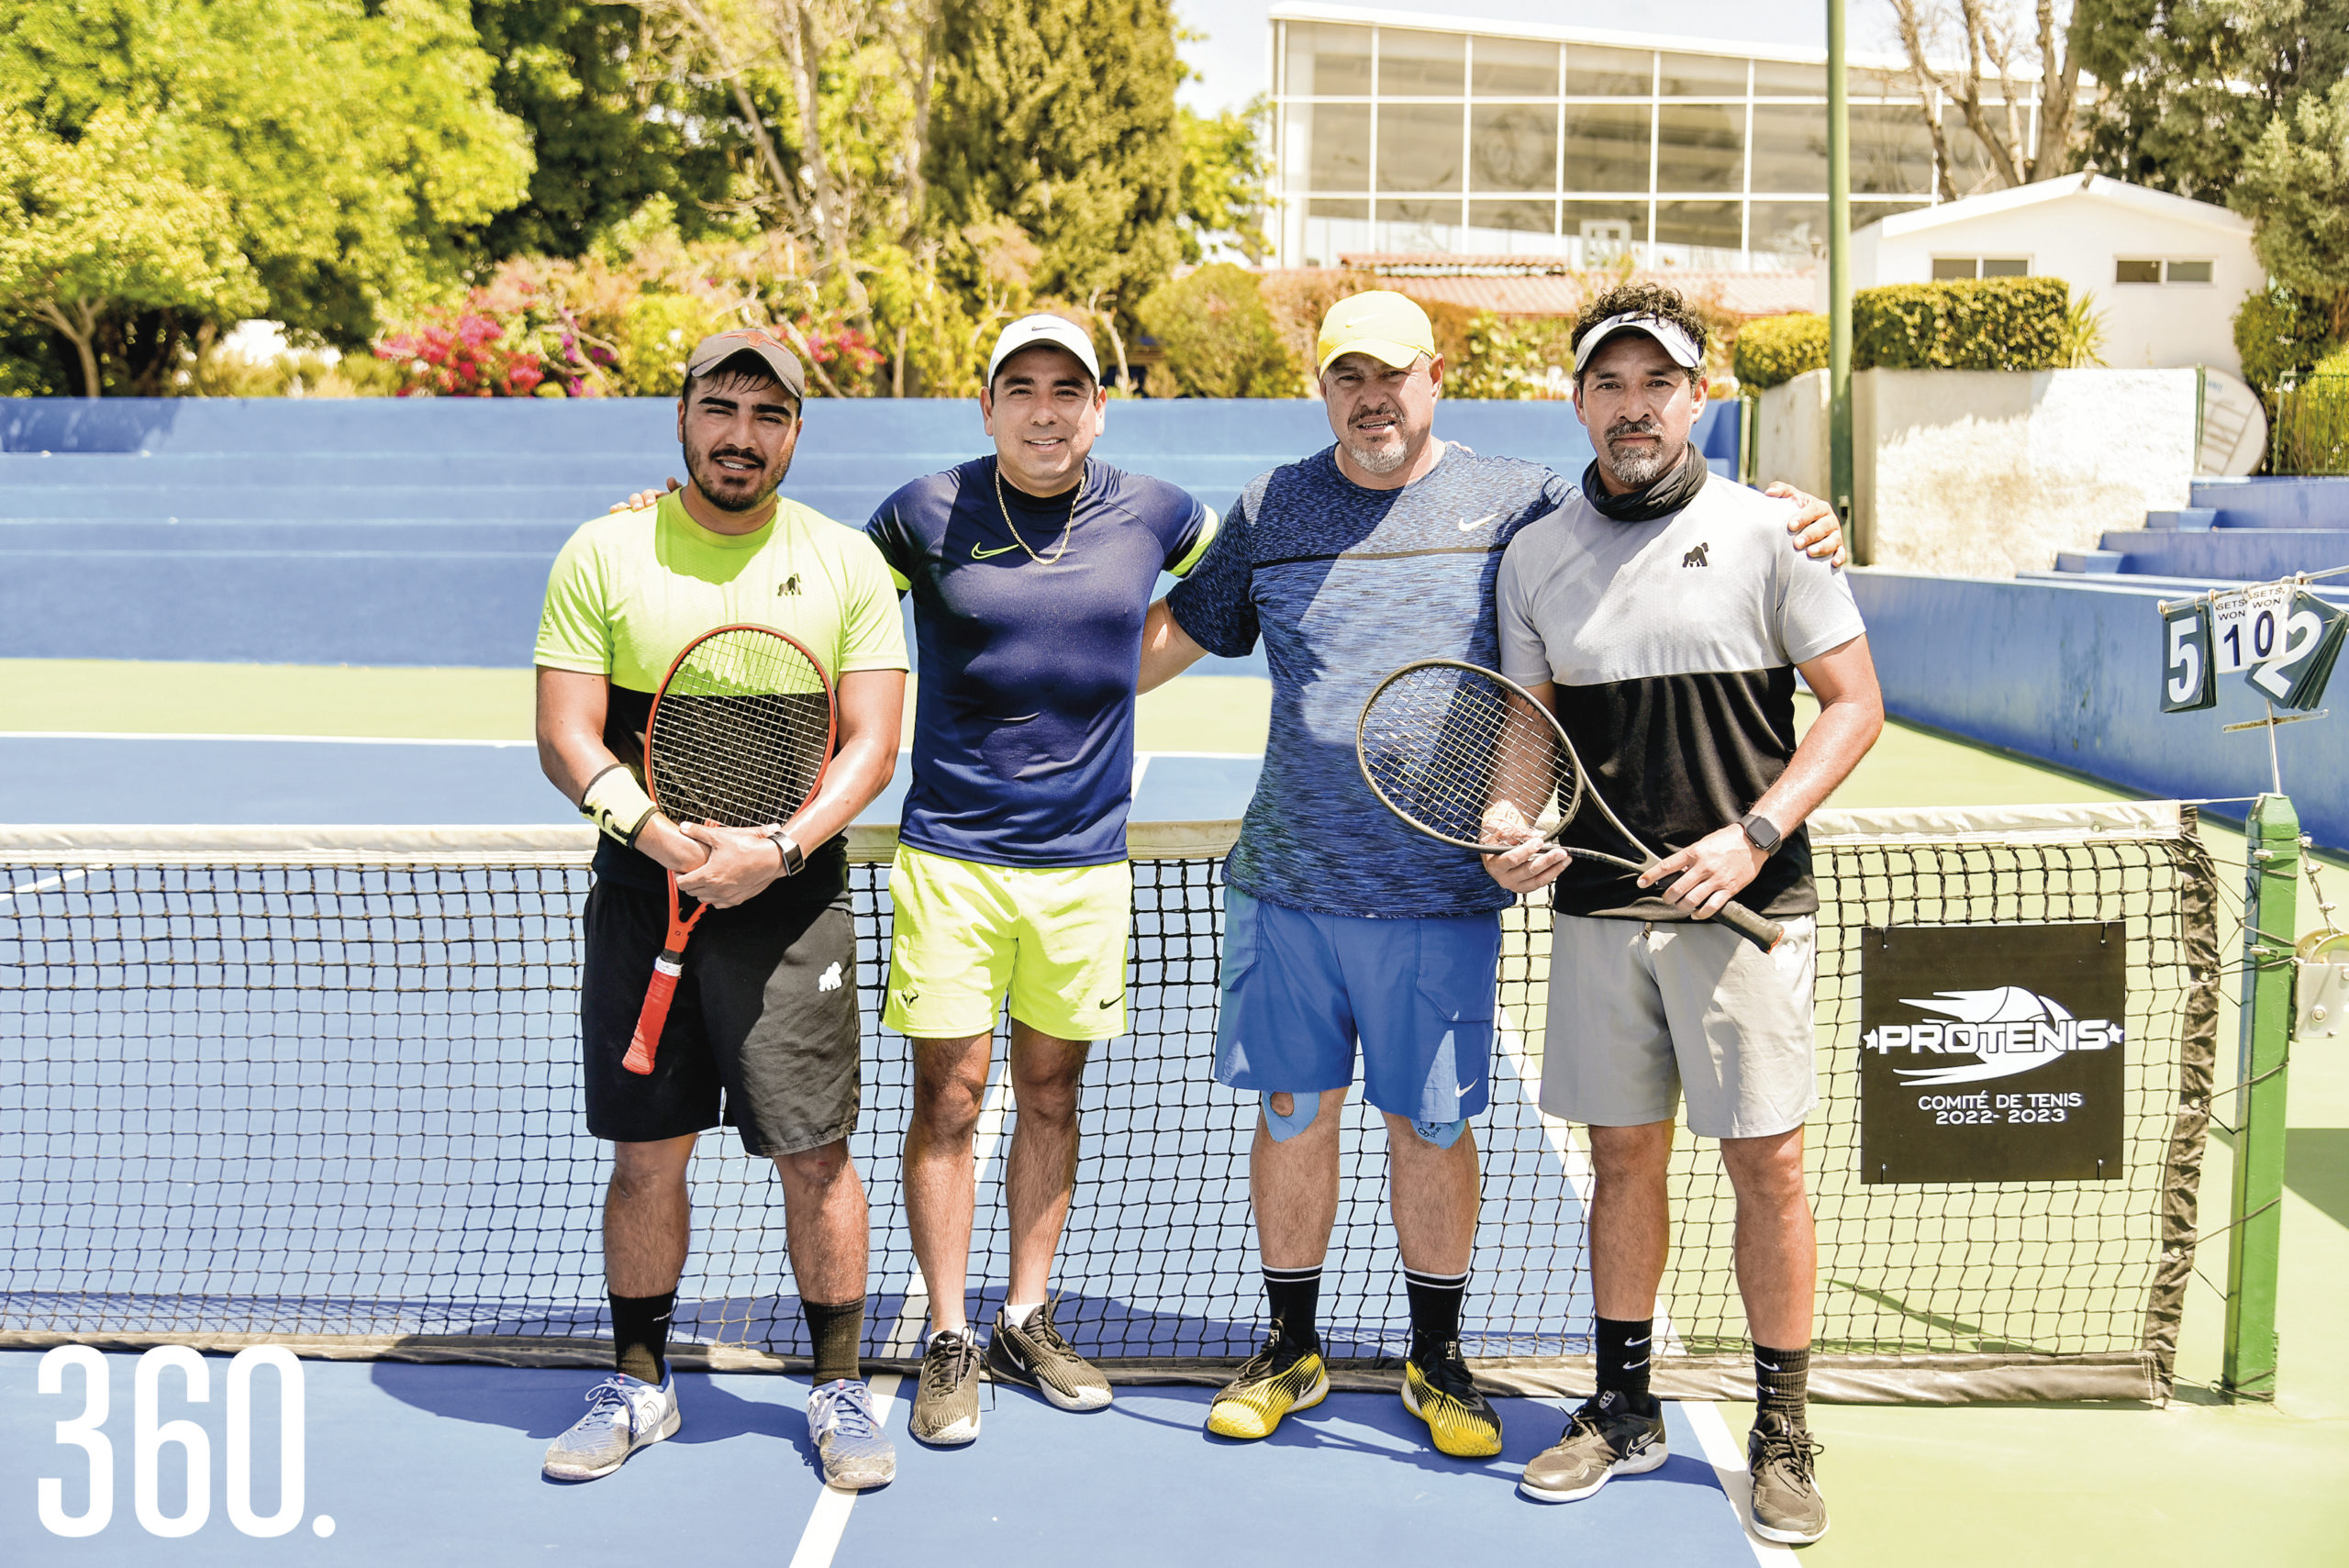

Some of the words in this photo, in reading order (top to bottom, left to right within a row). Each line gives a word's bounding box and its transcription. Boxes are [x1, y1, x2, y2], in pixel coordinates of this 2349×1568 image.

[2253, 598, 2281, 609] WON
[2254, 588, 2283, 599] SETS
[2217, 600, 2245, 611] SETS
[2218, 610, 2246, 621] WON
[2254, 610, 2275, 658] 0
[2223, 624, 2241, 667] 1
[2252, 610, 2322, 699] 2
[2167, 616, 2199, 704] 5
[1878, 1018, 2110, 1055] PROTENIS
[1918, 1089, 1989, 1110] COMITÉ
[1996, 1093, 2022, 1108] DE
[2026, 1092, 2083, 1107] TENIS
[2007, 1108, 2066, 1124] 2023
